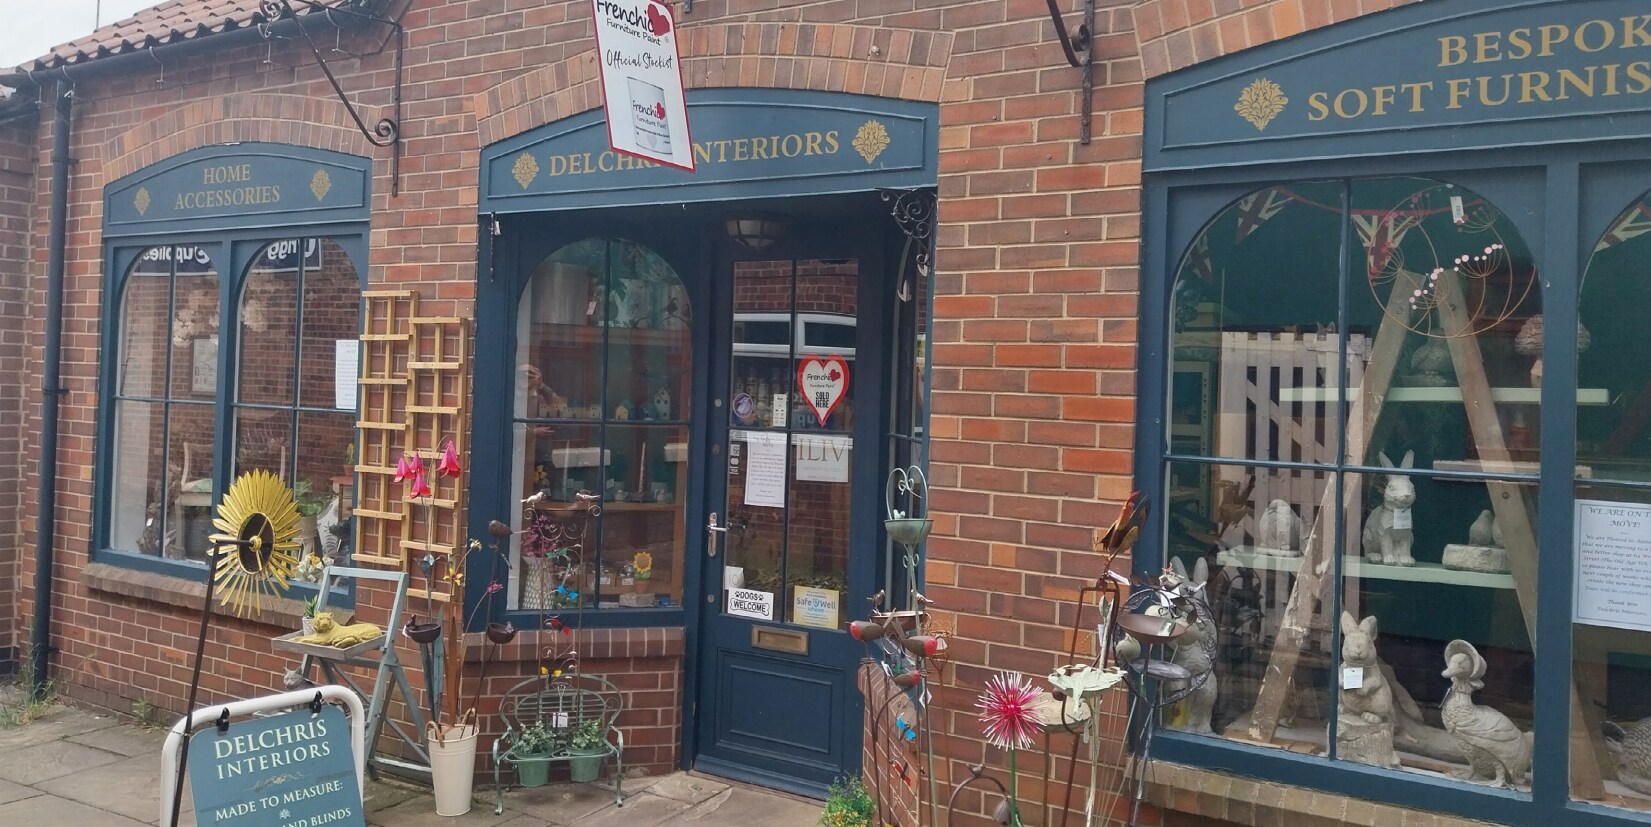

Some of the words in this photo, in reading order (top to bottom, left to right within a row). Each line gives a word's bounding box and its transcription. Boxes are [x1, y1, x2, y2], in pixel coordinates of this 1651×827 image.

[607, 18, 641, 38] Furniture
[643, 32, 661, 46] Paint
[606, 49, 641, 69] Official
[642, 52, 673, 69] Stockist
[1308, 81, 1433, 121] SOFT
[693, 130, 839, 164] NTERIORS
[203, 164, 251, 184] HOME
[174, 186, 280, 211] ACCESSORIES
[816, 400, 829, 408] HERE
[798, 438, 847, 462] ILIV
[1610, 520, 1641, 528] MOVE!
[733, 600, 766, 612] WELCOME
[740, 591, 758, 600] DOGS
[796, 598, 812, 606] Safe
[820, 601, 836, 609] Well
[214, 719, 327, 760] DELCHRIS
[216, 741, 331, 780] INTERIORS
[216, 800, 257, 822] MADE
[259, 795, 279, 809] TO
[283, 780, 344, 804] MEASURE:
[310, 807, 352, 827] BLINDS
